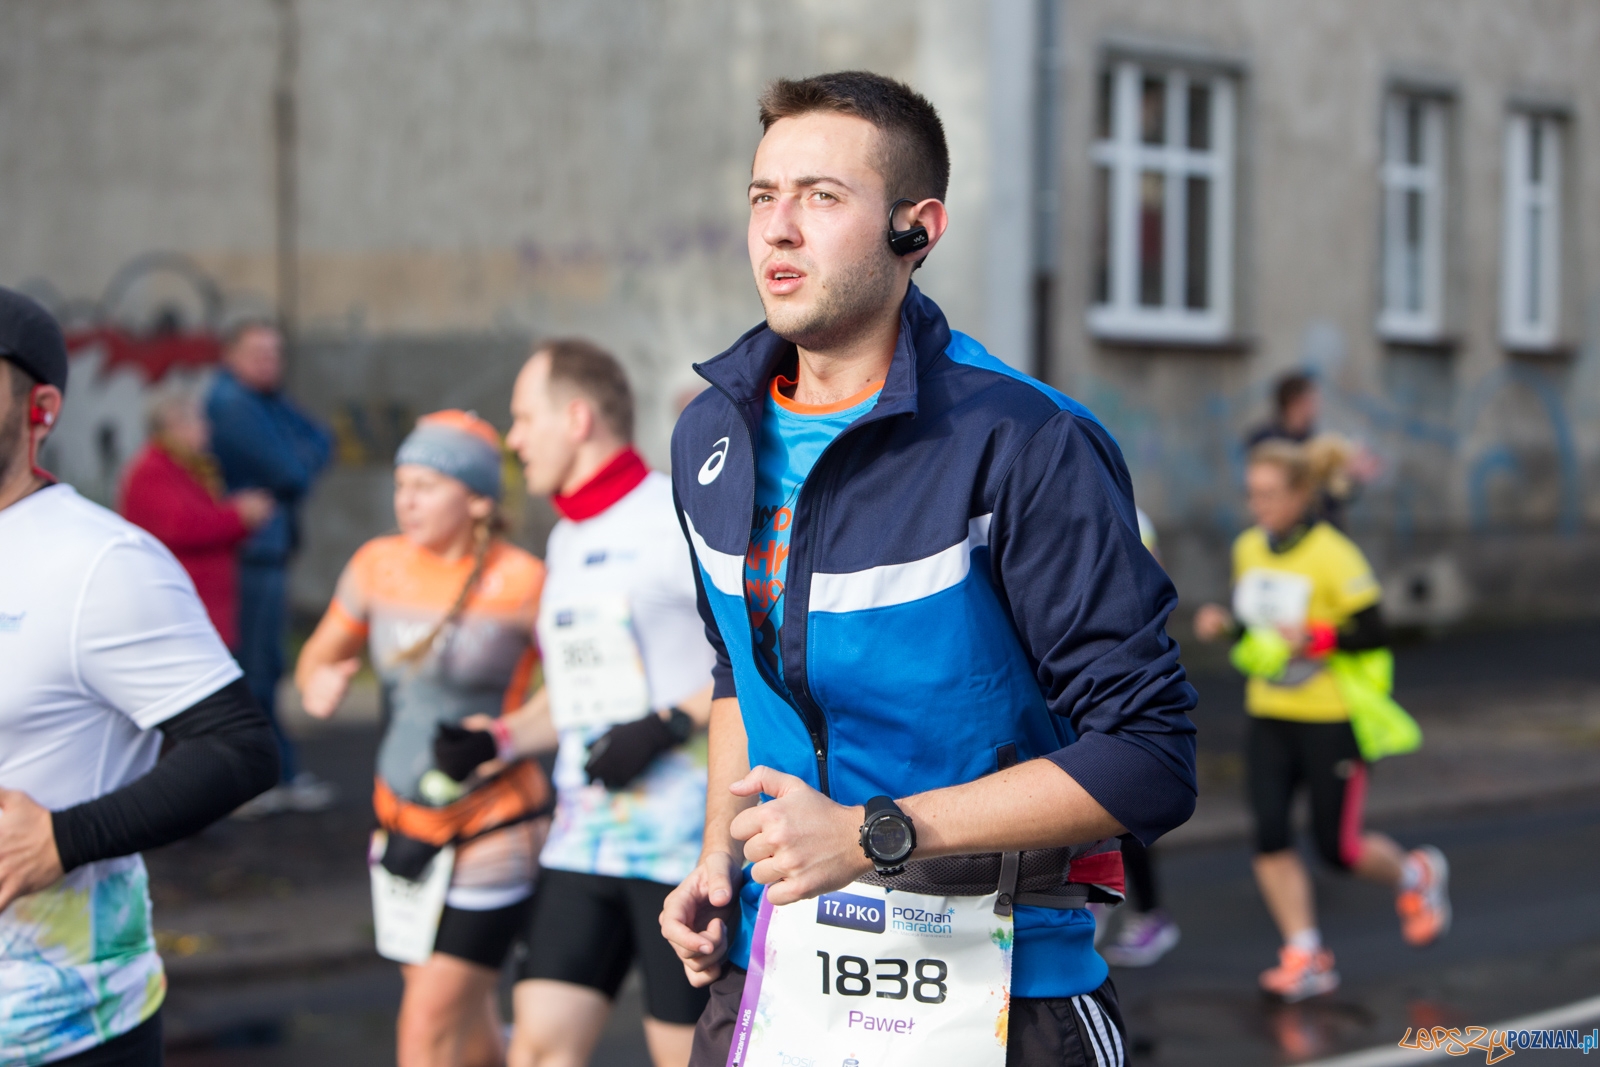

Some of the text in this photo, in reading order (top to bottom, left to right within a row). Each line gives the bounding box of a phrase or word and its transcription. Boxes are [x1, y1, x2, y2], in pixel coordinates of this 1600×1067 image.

[824, 899, 880, 923] 17. PKO
[892, 920, 952, 934] maraton
[816, 950, 948, 1005] 1838
[848, 1010, 916, 1035] Paweł
